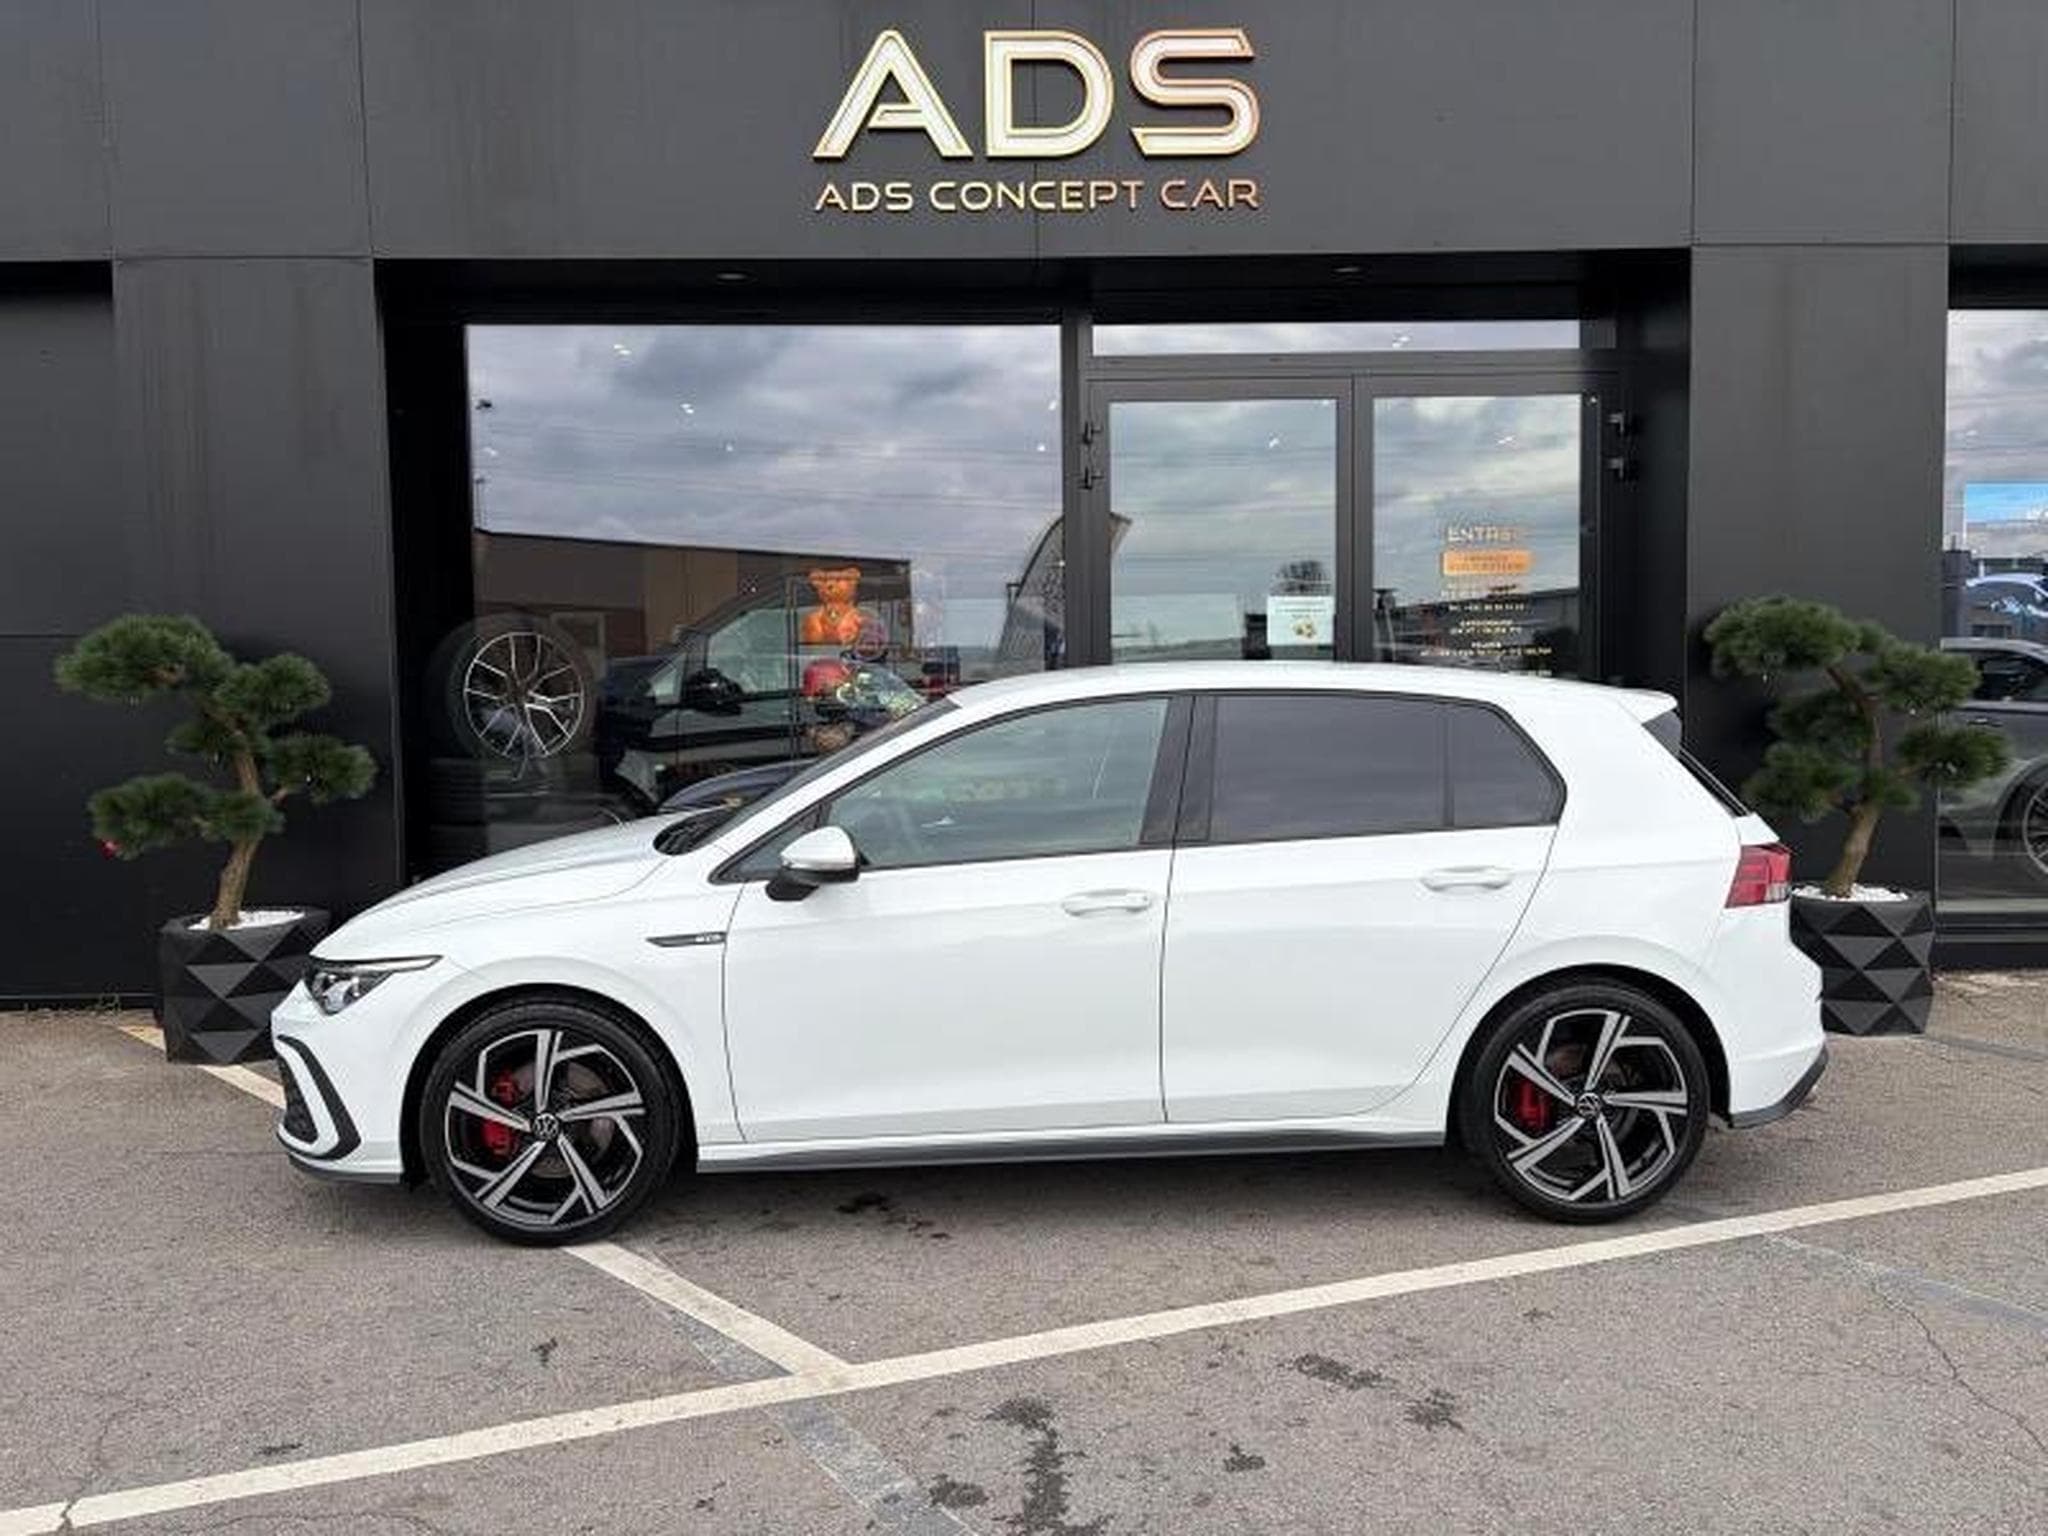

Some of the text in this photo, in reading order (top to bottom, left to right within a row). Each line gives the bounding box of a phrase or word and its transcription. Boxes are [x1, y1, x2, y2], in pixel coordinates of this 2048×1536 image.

[812, 29, 1261, 159] ADS
[814, 179, 1260, 212] ADS CONCEPT CAR
